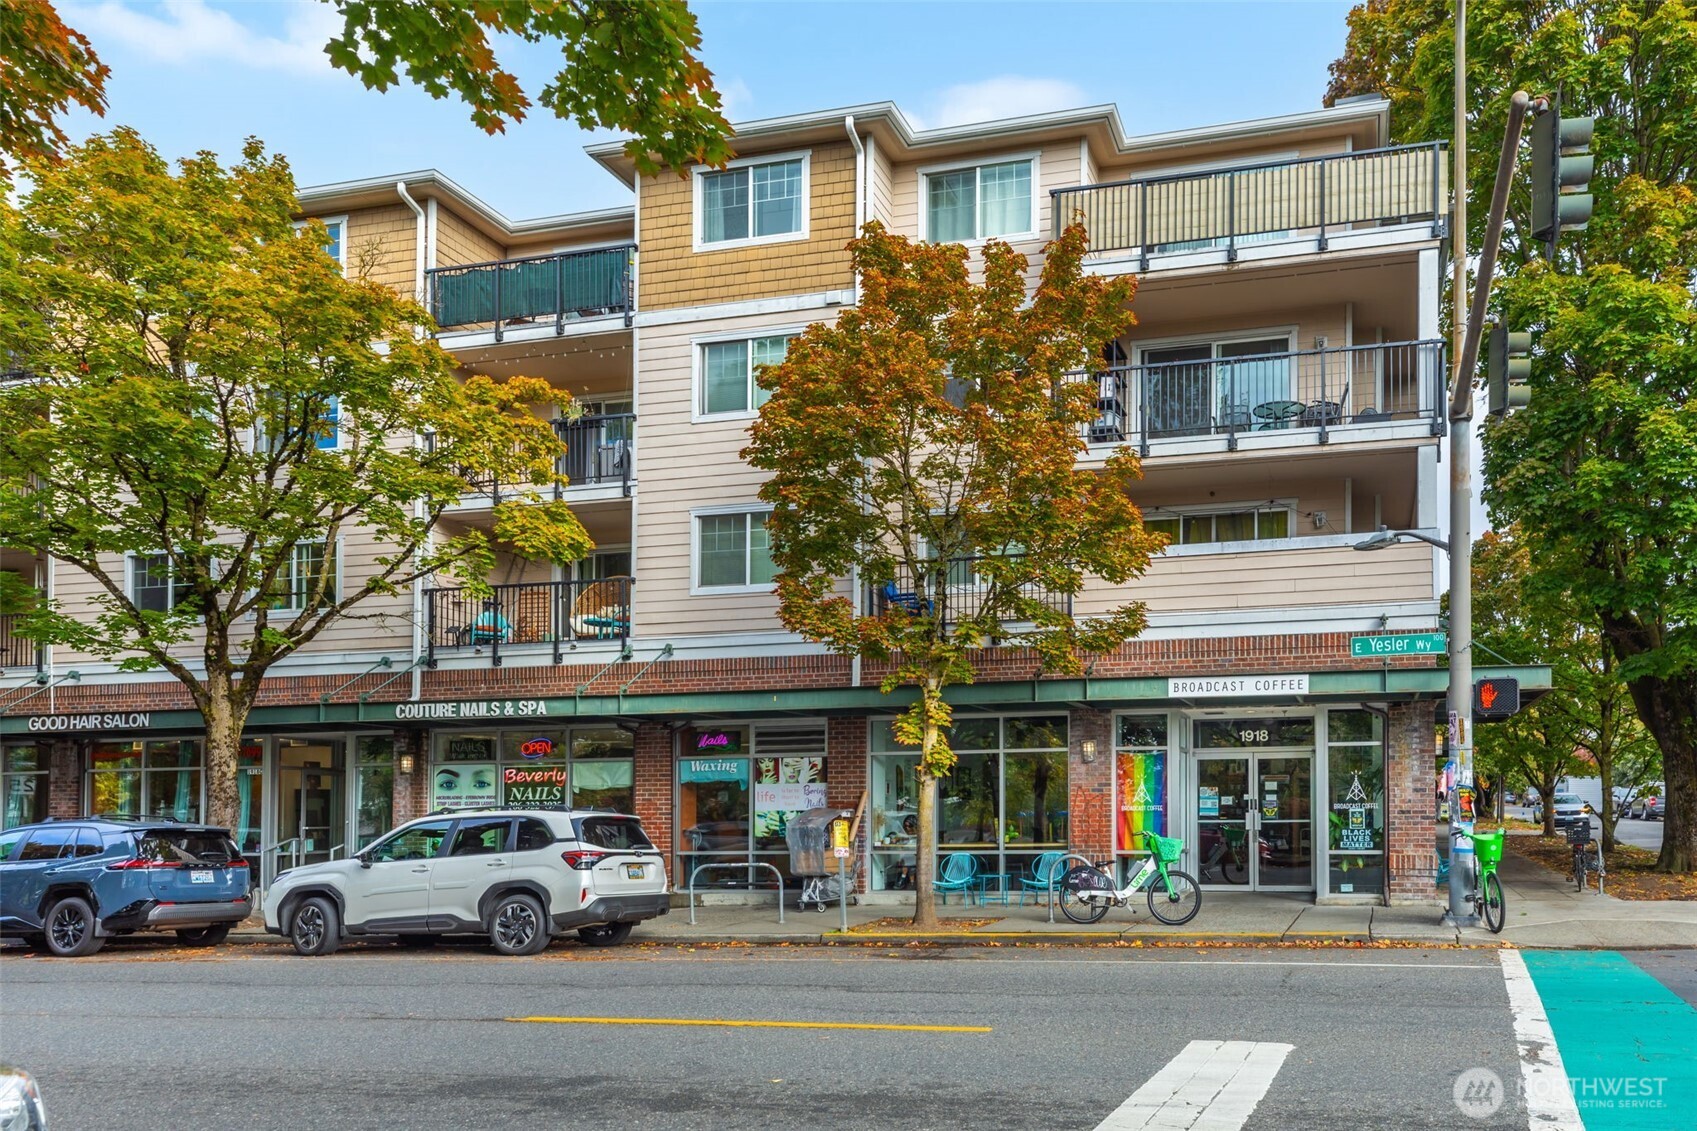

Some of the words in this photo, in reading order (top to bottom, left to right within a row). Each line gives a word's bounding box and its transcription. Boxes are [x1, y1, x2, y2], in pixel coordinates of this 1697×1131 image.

[1355, 642, 1362, 653] E
[1369, 637, 1410, 652] Yesler
[1415, 639, 1432, 652] Wy
[1173, 680, 1245, 693] BROADCAST
[1255, 678, 1304, 691] COFFEE
[395, 702, 457, 719] COUTURE
[460, 701, 500, 717] NAILS
[504, 701, 515, 716] &
[518, 700, 547, 716] SPA
[28, 716, 68, 731] GOOD
[70, 714, 101, 730] HAIR
[103, 713, 150, 728] SALON
[1239, 729, 1269, 742] 1918
[452, 740, 486, 752] NAILS
[521, 742, 551, 754] OPEN
[691, 759, 738, 773] Waxing
[504, 766, 567, 787] Beverly
[509, 786, 562, 801] NAILS
[757, 790, 776, 802] life
